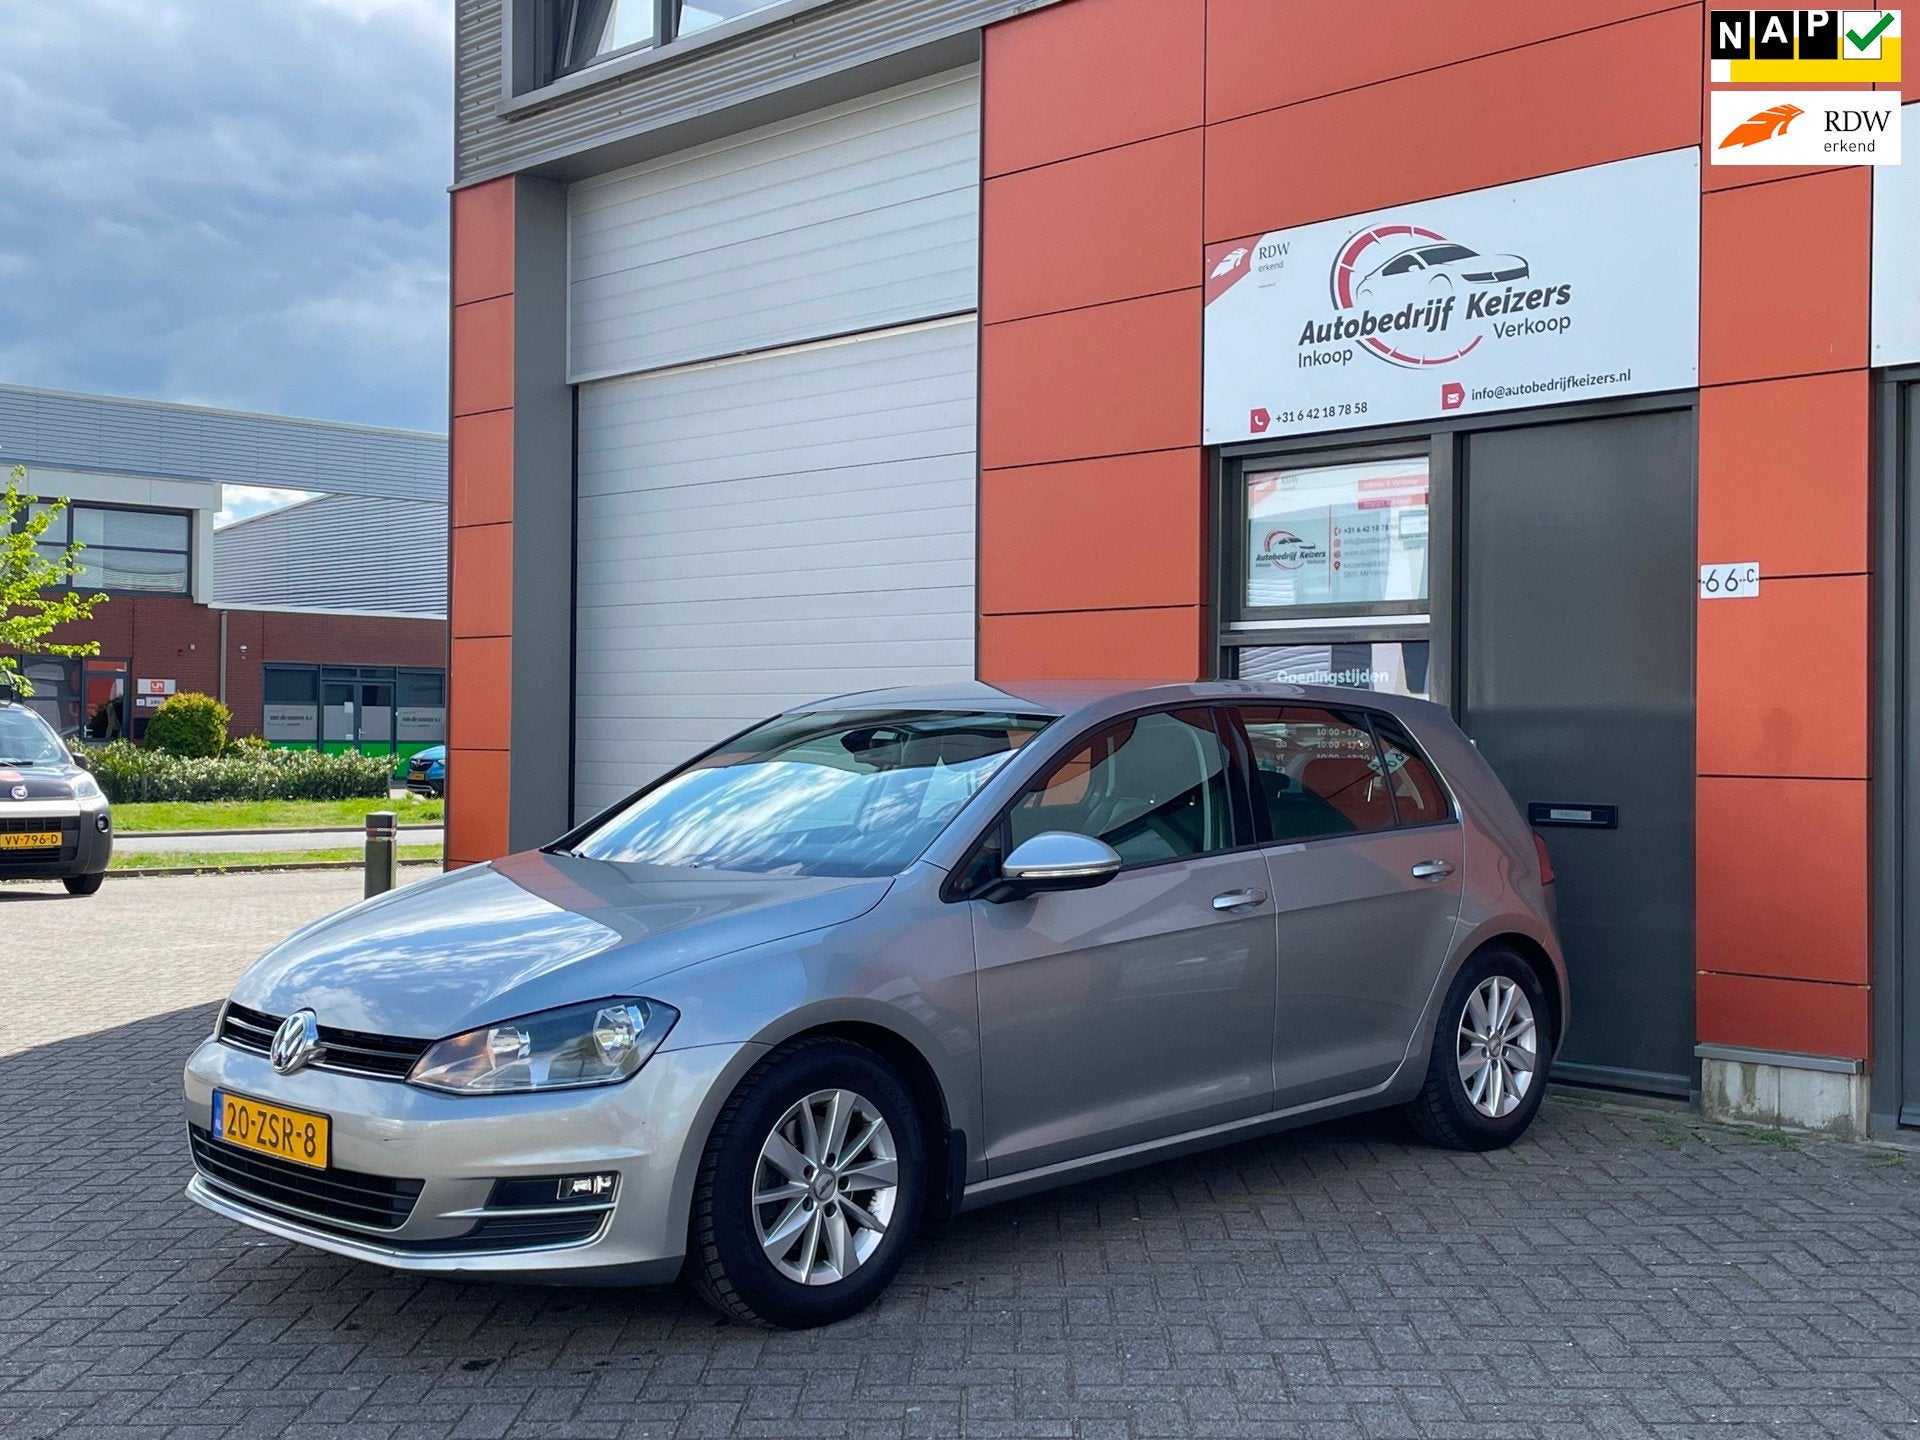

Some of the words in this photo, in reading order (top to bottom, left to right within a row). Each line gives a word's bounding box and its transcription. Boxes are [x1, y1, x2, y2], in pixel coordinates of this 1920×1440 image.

[1259, 242, 1290, 260] RDW
[1258, 261, 1284, 272] erkend
[1298, 296, 1456, 346] Autobedrijf
[1465, 283, 1572, 320] Keizers
[1493, 315, 1571, 339] Verkoop
[1298, 349, 1353, 368] Inkoop
[1471, 368, 1632, 401] info@autobedrijfkeizers.nl
[1276, 411, 1295, 423] +31
[1297, 410, 1304, 421] 6
[1306, 408, 1320, 419] 42
[1322, 406, 1335, 418] 18
[1338, 403, 1352, 416] 78
[1354, 401, 1368, 414] 58
[1255, 551, 1297, 562] Autobedrijf
[1300, 550, 1326, 559] Keizers
[1277, 668, 1389, 687] Openingstijden
[1317, 728, 1340, 736] 10:00
[4, 834, 58, 846] VV-796-D
[227, 1102, 316, 1158] 20-ZSR-8
